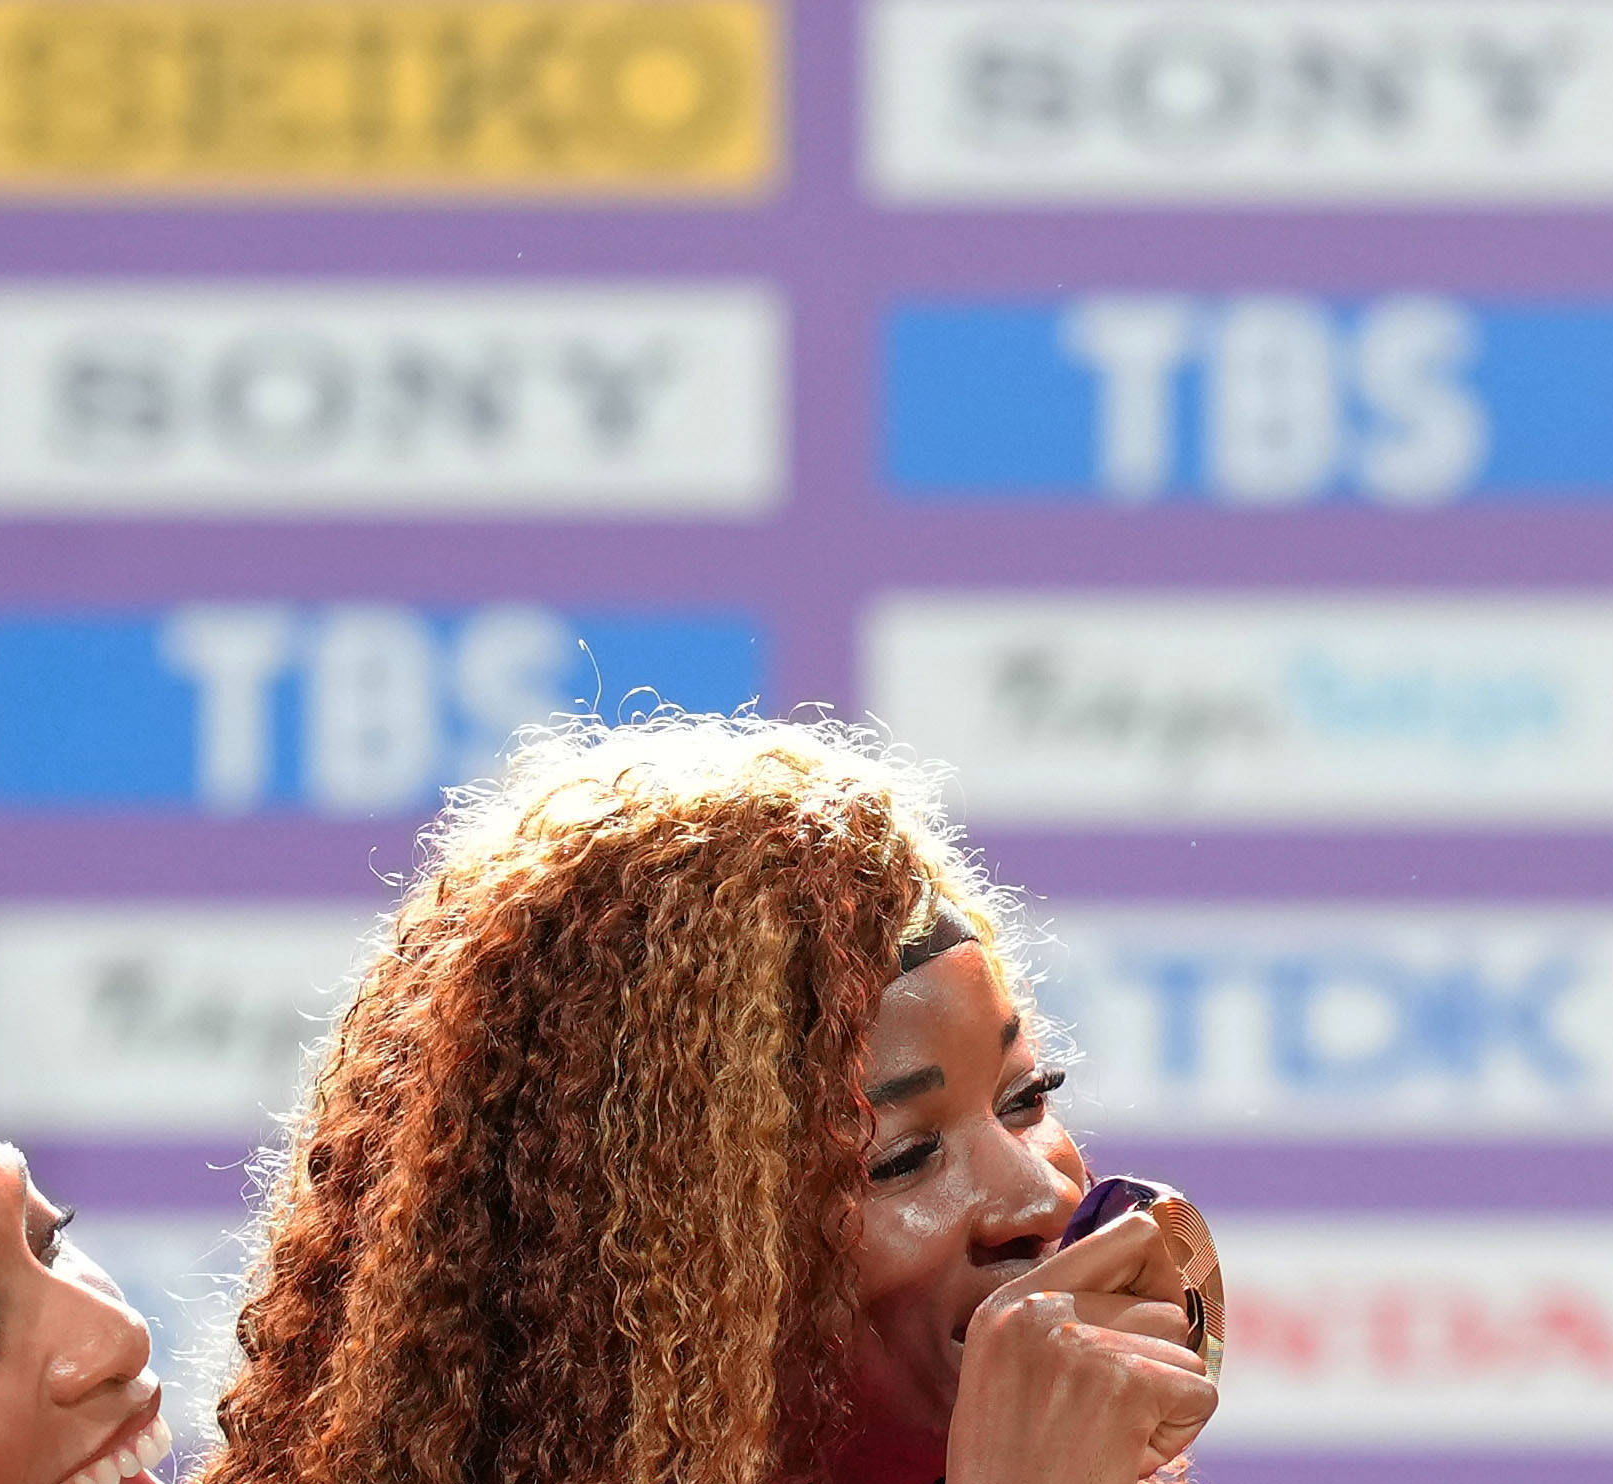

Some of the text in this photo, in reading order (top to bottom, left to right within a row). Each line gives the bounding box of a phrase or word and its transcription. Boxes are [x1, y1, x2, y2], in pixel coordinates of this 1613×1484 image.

[947, 26, 1581, 145] SONY
[44, 337, 677, 456] SONY
[1052, 295, 1479, 502] TBS
[1114, 957, 1588, 1095] TDK
